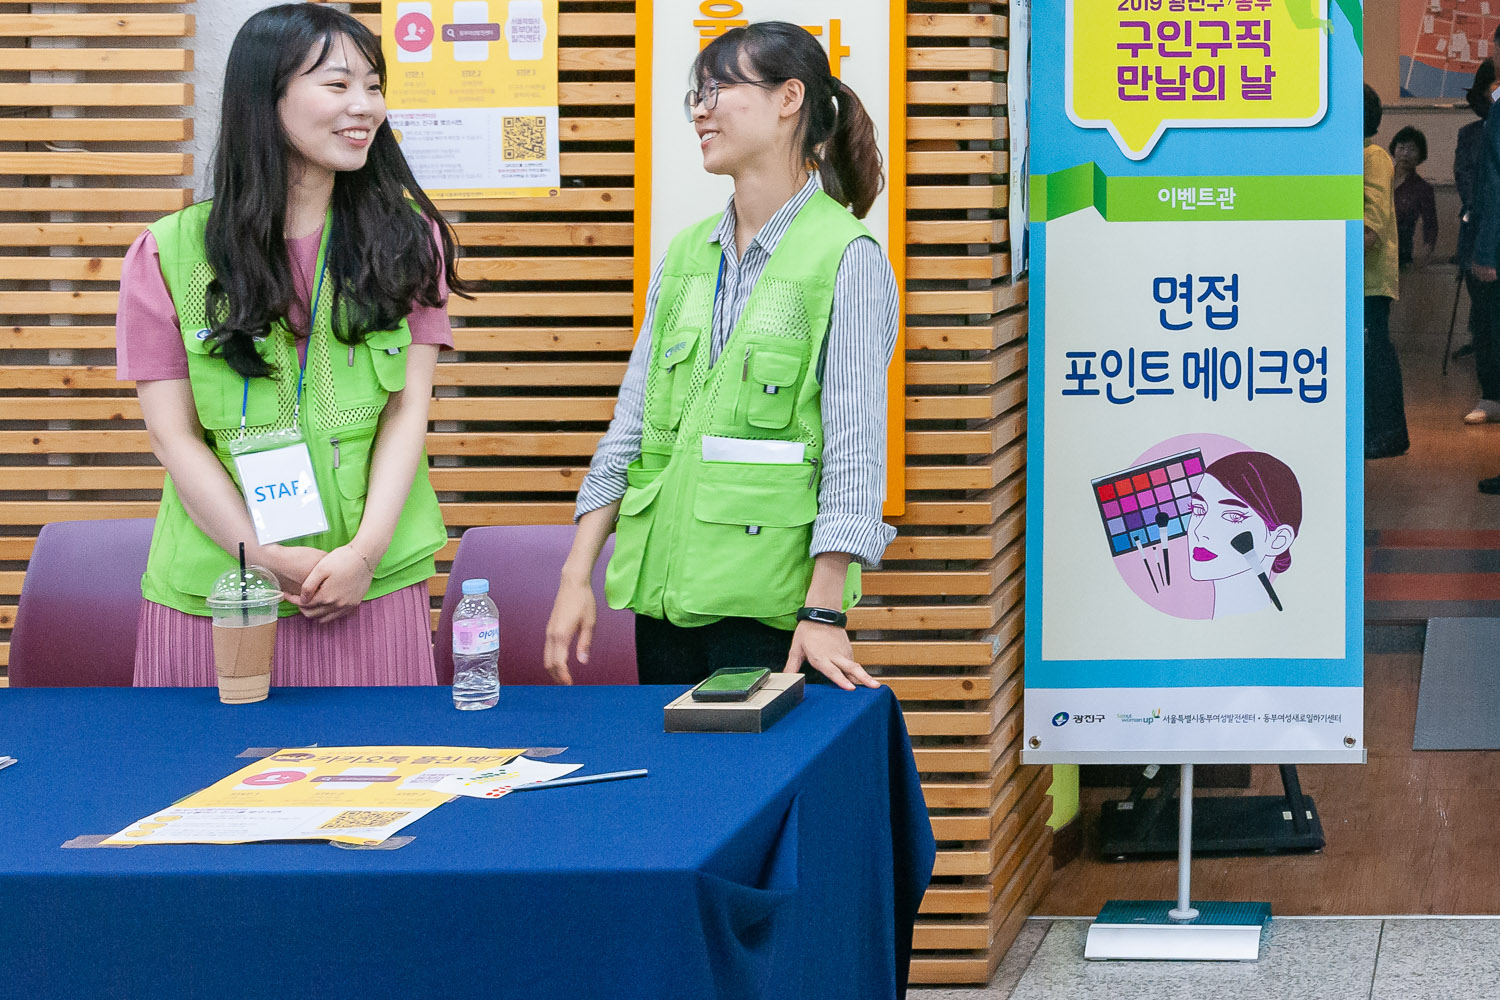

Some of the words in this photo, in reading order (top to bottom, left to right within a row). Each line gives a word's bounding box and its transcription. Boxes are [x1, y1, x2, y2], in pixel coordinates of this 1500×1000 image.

[1116, 19, 1272, 58] 구인구직
[1116, 65, 1226, 101] 만남의
[1240, 65, 1277, 101] 날
[1157, 187, 1237, 210] 이벤트관
[1152, 273, 1240, 332] 면접
[1061, 347, 1175, 406] 포인트
[1182, 346, 1328, 405] 메이크업
[1072, 713, 1106, 724] 광진구
[1143, 716, 1154, 725] up
